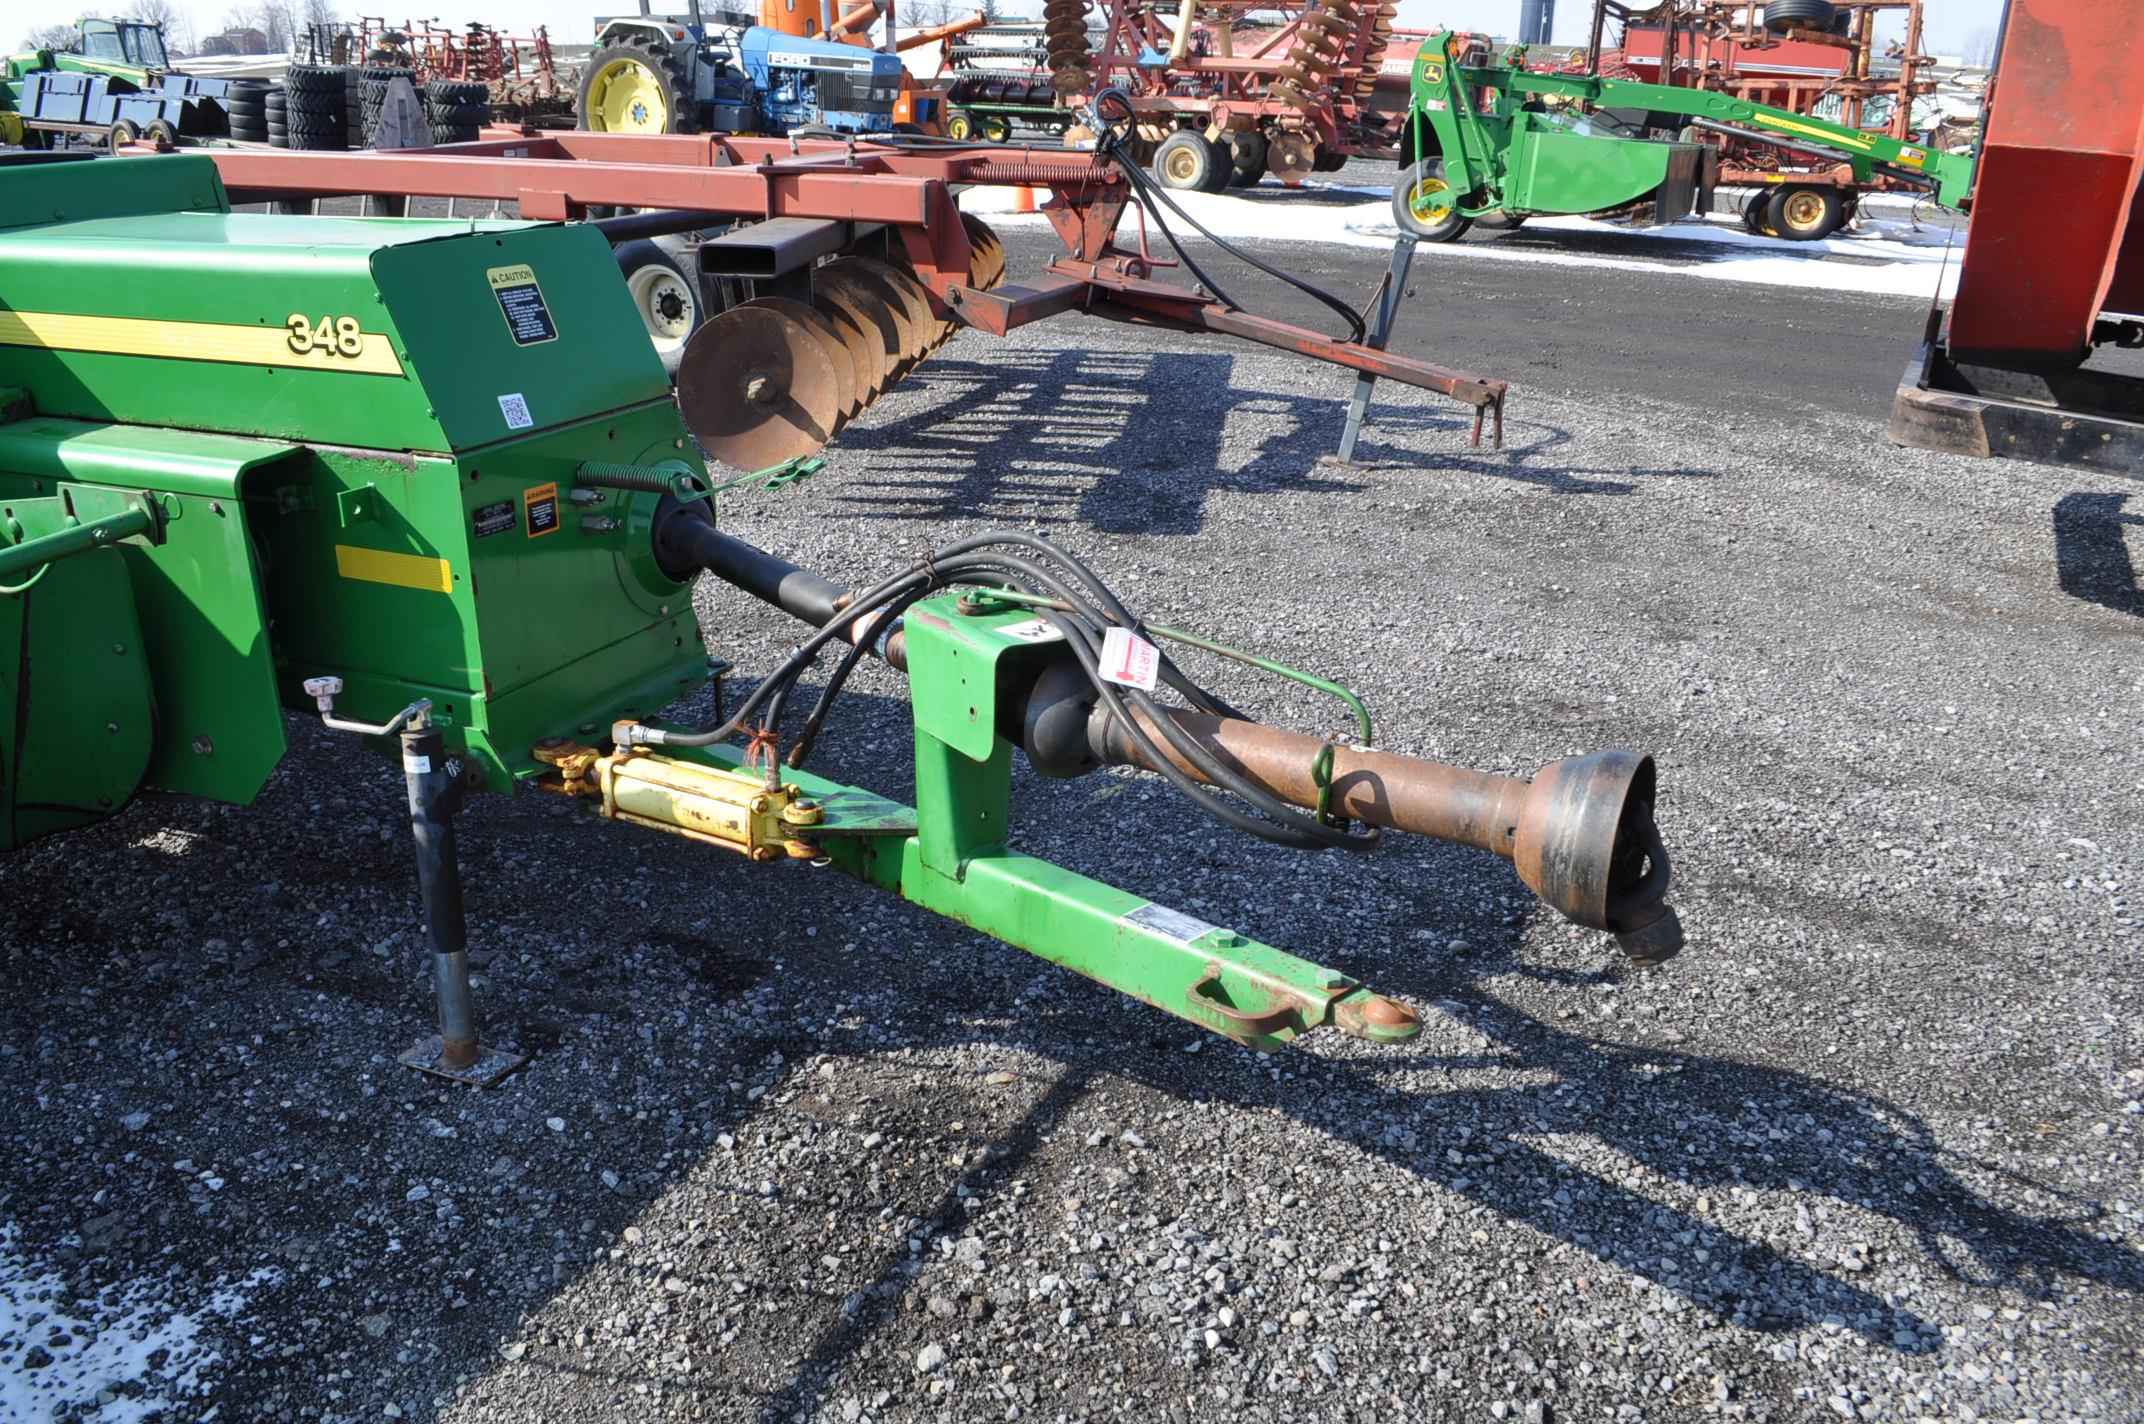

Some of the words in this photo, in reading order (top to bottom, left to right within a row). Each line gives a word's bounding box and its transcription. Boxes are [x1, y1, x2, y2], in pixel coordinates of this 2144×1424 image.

[771, 54, 810, 65] FORD
[499, 270, 533, 282] CAUTION
[286, 313, 363, 358] 348
[1135, 641, 1152, 686] MARTIN
